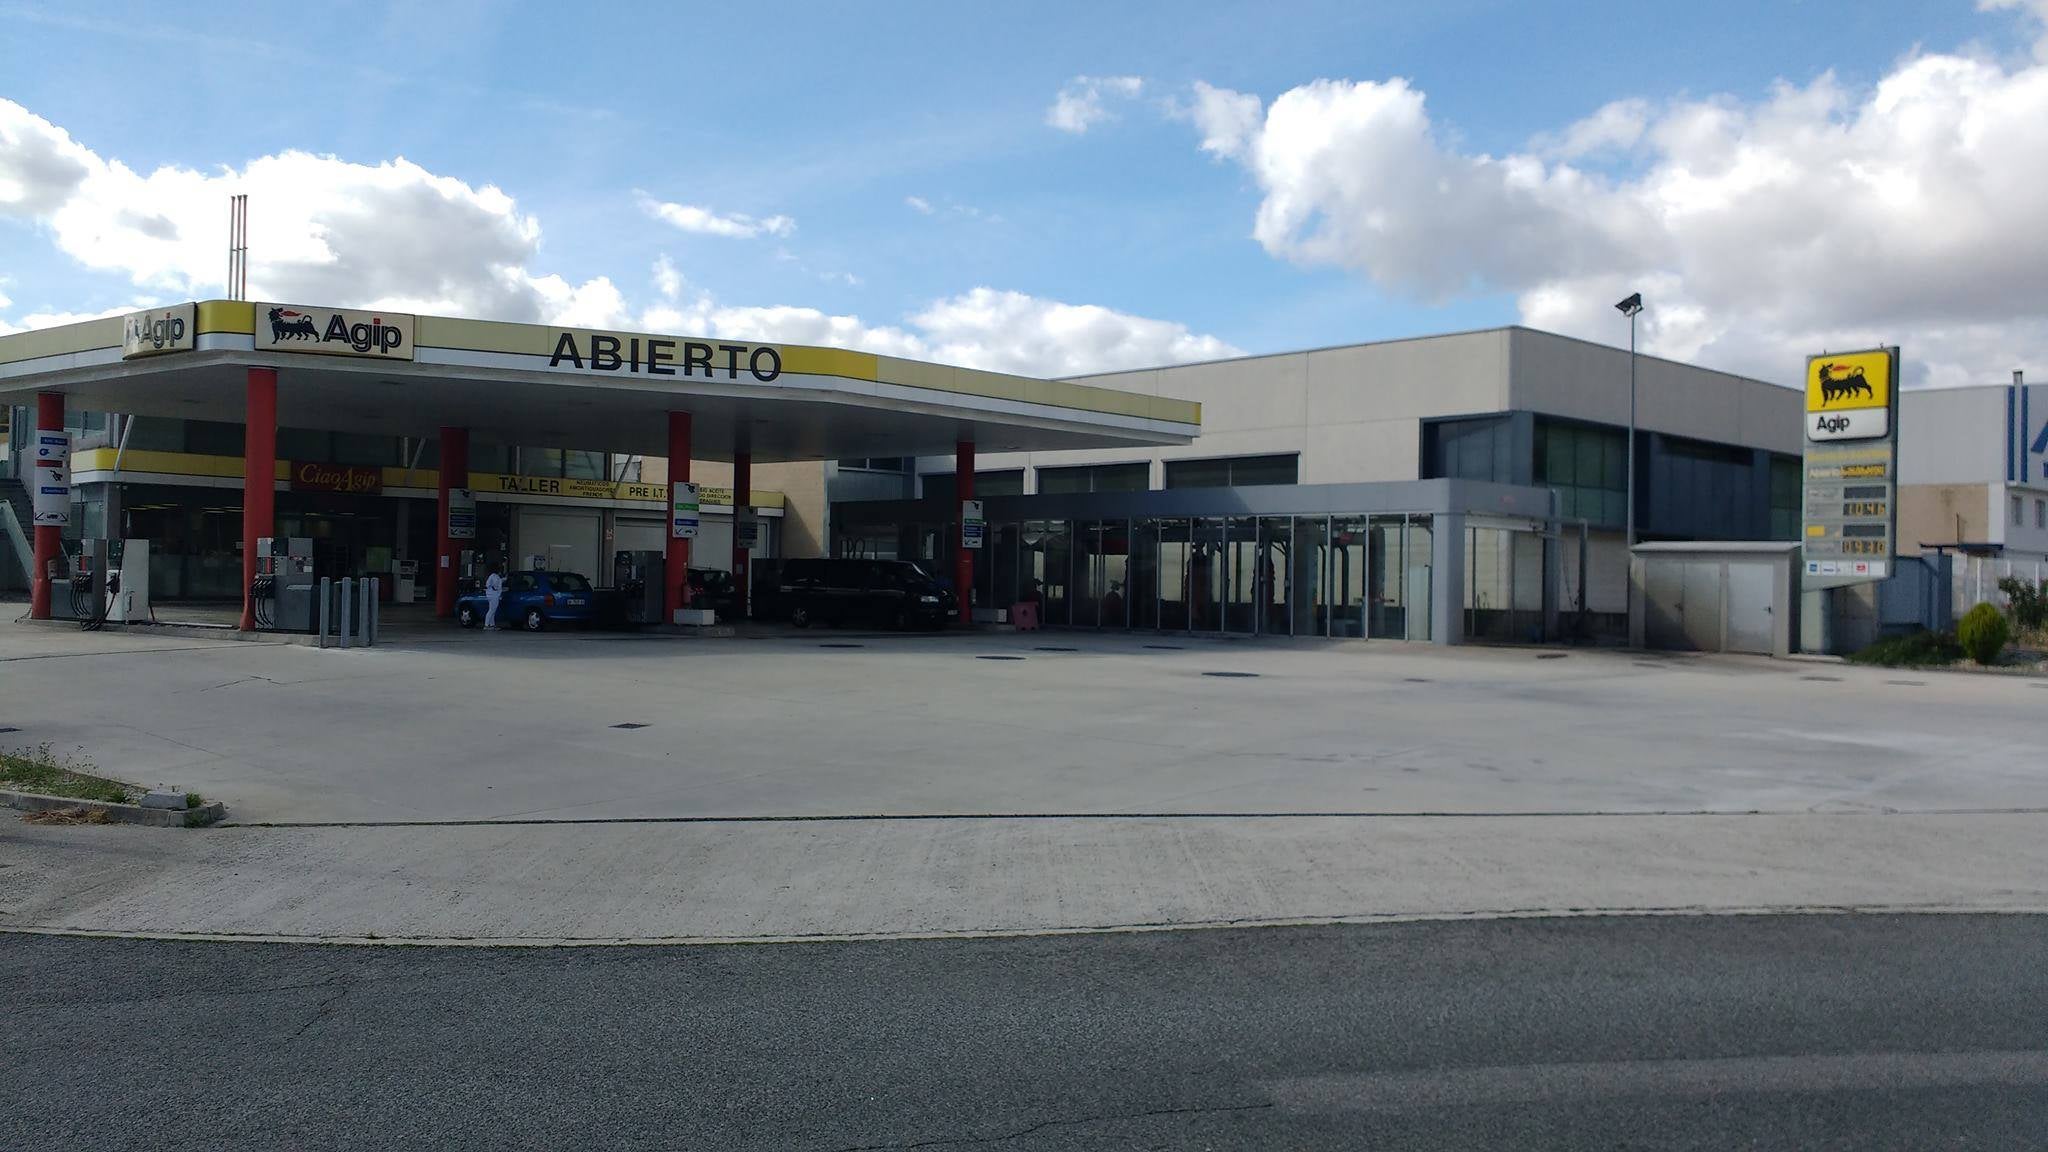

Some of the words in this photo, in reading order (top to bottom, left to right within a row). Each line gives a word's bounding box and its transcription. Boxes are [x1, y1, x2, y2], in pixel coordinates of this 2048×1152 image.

[140, 312, 185, 349] Agip
[322, 313, 402, 353] Agip
[549, 332, 782, 382] ABIERTO
[1816, 414, 1850, 433] Agip
[629, 487, 649, 497] PRE
[653, 488, 668, 498] I.T.
